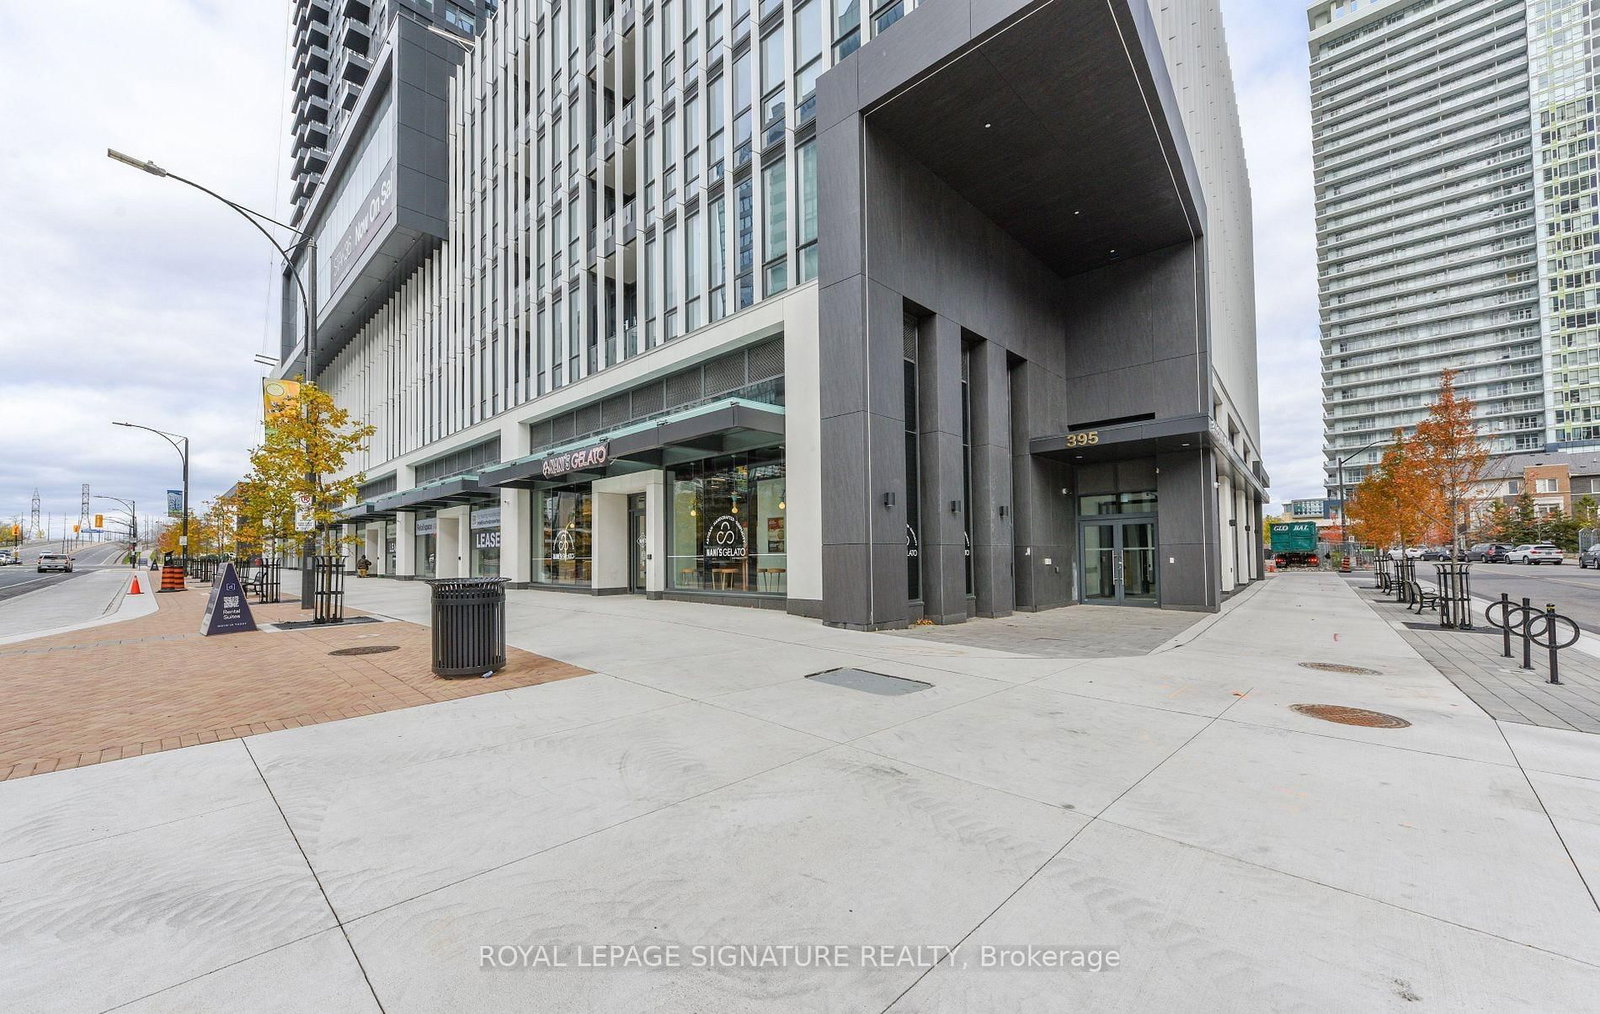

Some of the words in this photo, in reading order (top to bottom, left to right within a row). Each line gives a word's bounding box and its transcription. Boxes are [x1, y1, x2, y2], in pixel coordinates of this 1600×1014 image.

[355, 212, 369, 246] Now
[369, 196, 380, 223] On
[381, 170, 393, 206] Sal
[1066, 431, 1099, 447] 395
[571, 446, 606, 469] GELATO
[476, 531, 501, 549] LEASE
[706, 547, 722, 557] NANI'S
[722, 547, 746, 557] GELATO
